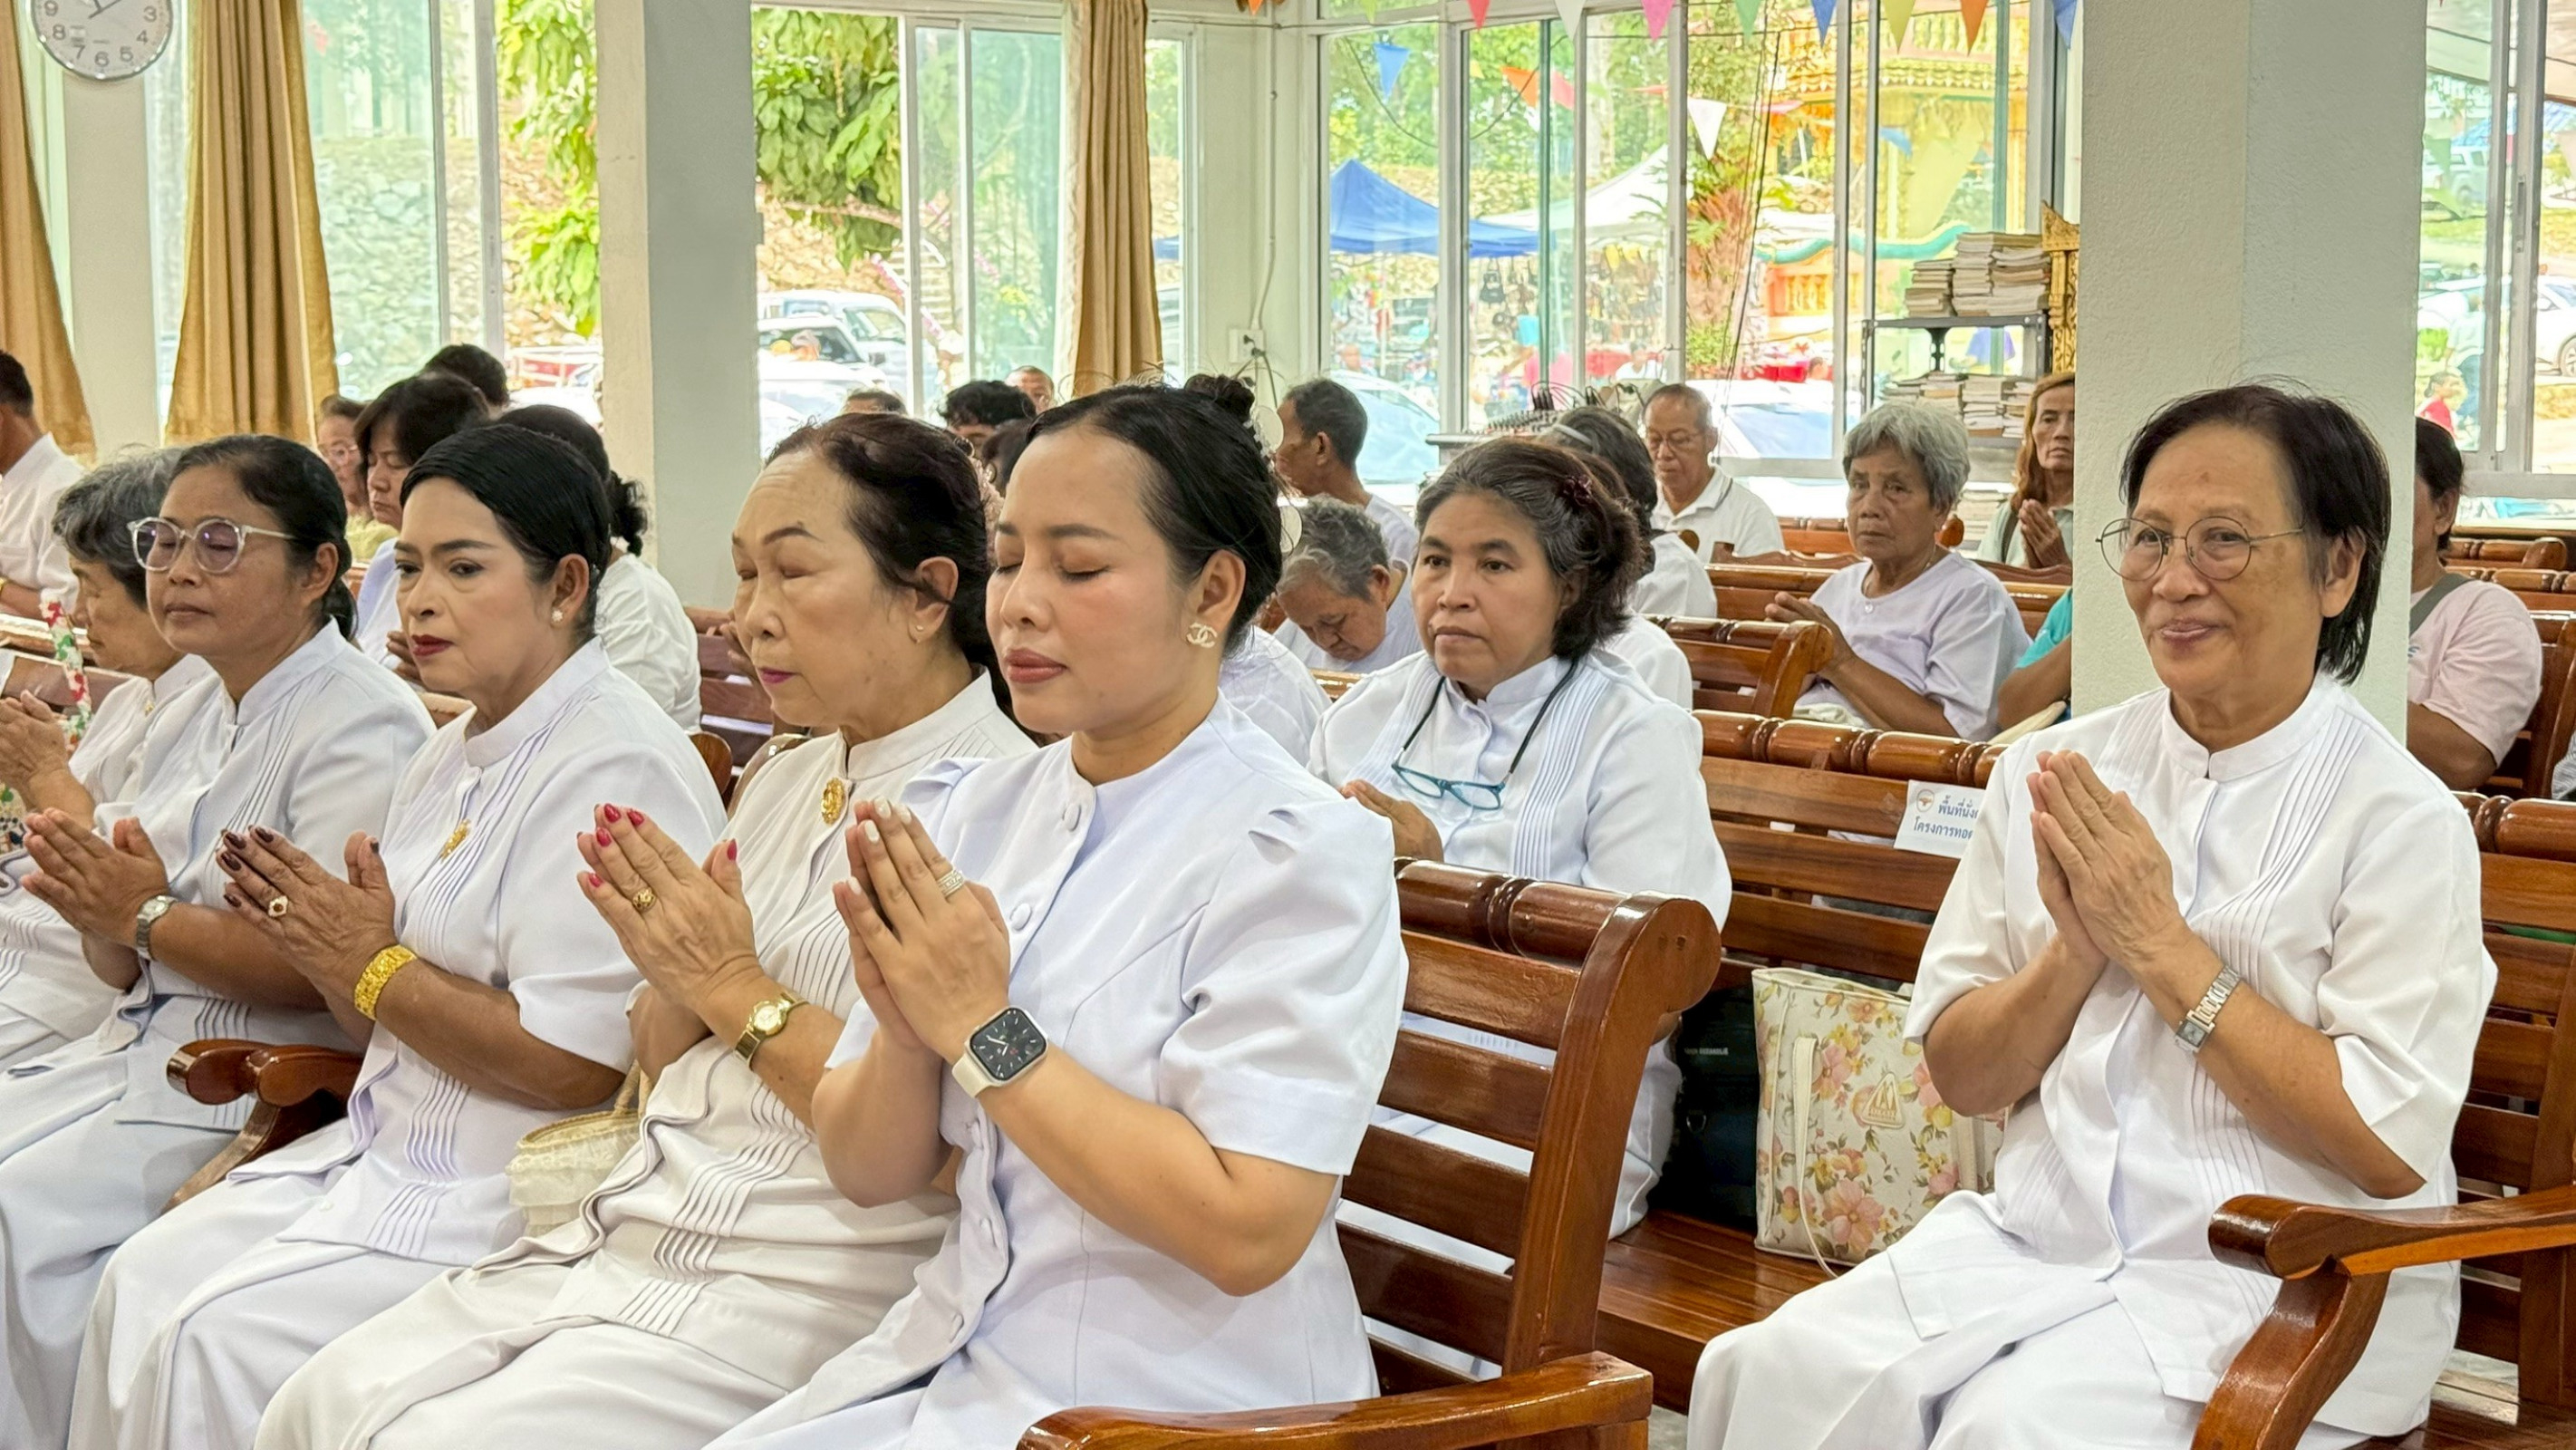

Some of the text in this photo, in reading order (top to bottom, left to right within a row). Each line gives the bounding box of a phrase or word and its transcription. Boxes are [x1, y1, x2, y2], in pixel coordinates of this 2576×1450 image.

[44, 1, 58, 16] 9
[143, 6, 158, 22] 3
[53, 24, 66, 40] 8
[136, 30, 149, 44] 4
[73, 44, 86, 60] 7
[94, 52, 110, 66] 6
[120, 46, 134, 62] 5
